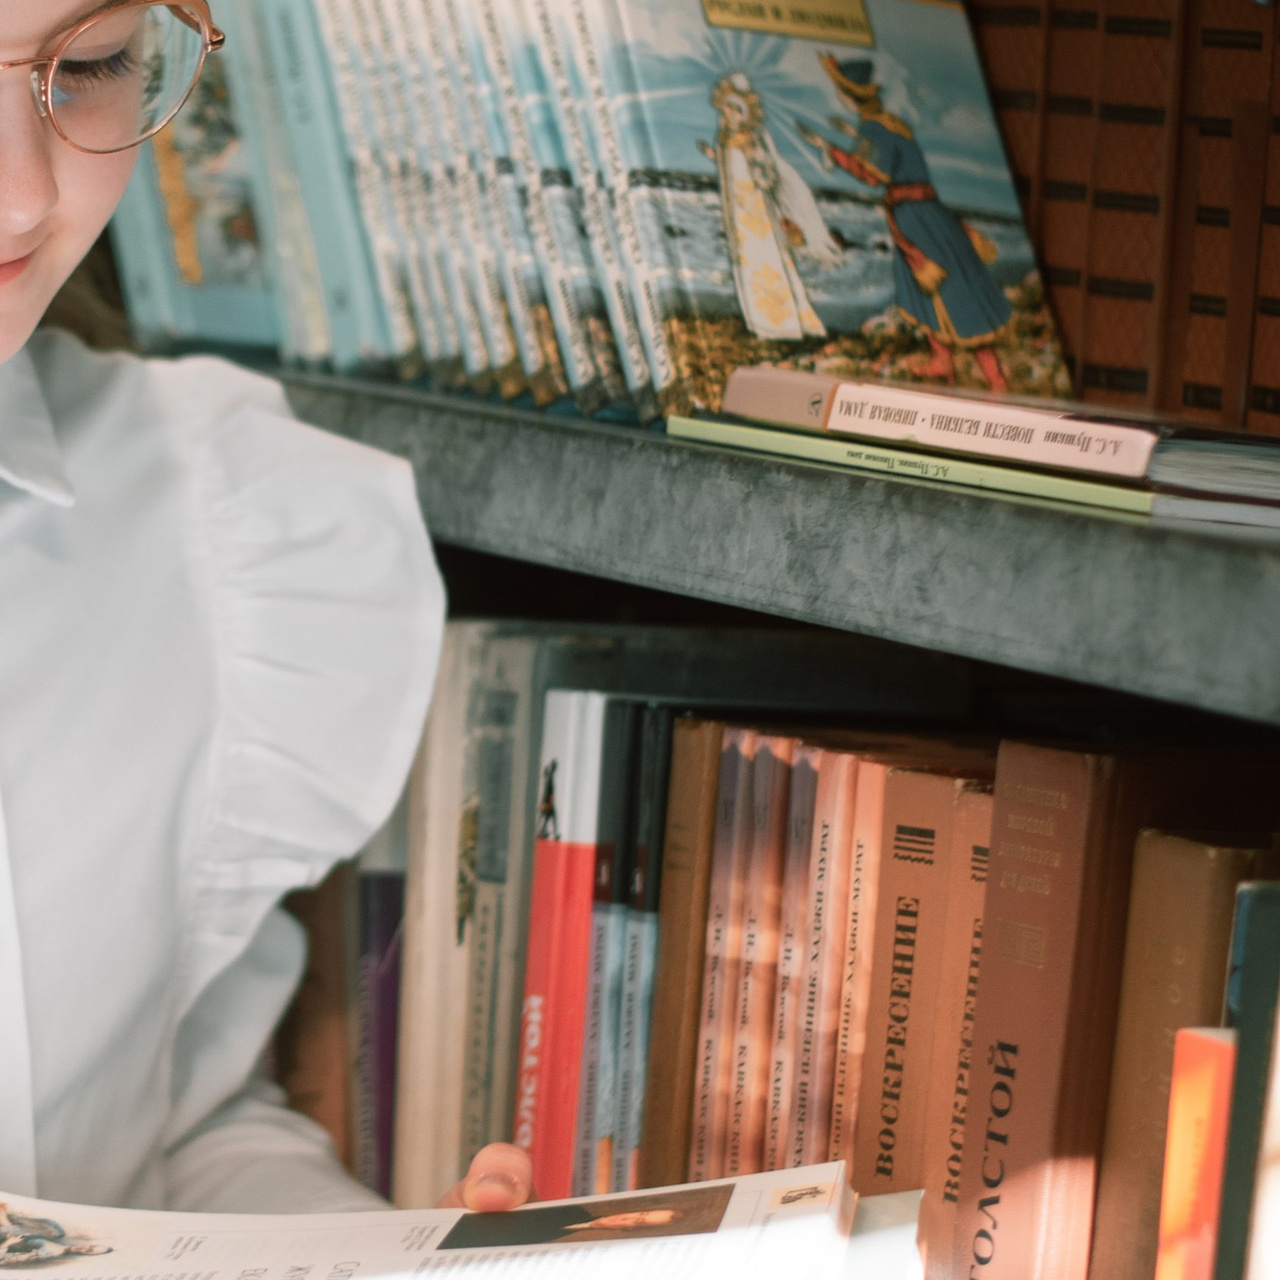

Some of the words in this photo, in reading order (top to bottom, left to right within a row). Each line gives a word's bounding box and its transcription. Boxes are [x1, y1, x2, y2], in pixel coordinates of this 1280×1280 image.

[838, 399, 869, 419] ДАМА
[869, 404, 919, 426] ПИКОВАЯ
[930, 413, 981, 436] БЕЛКИНА
[982, 421, 1035, 445] ПОВЕСТИ
[1042, 431, 1093, 453] Пушкин
[810, 819, 830, 962] ХАДЖИ-МУРАТ
[845, 839, 864, 983] ХАДЖИ-МУРАТ
[874, 896, 920, 1181] ВОСКРЕСЕНИЕ
[517, 995, 545, 1149] ОЛСТОЙ
